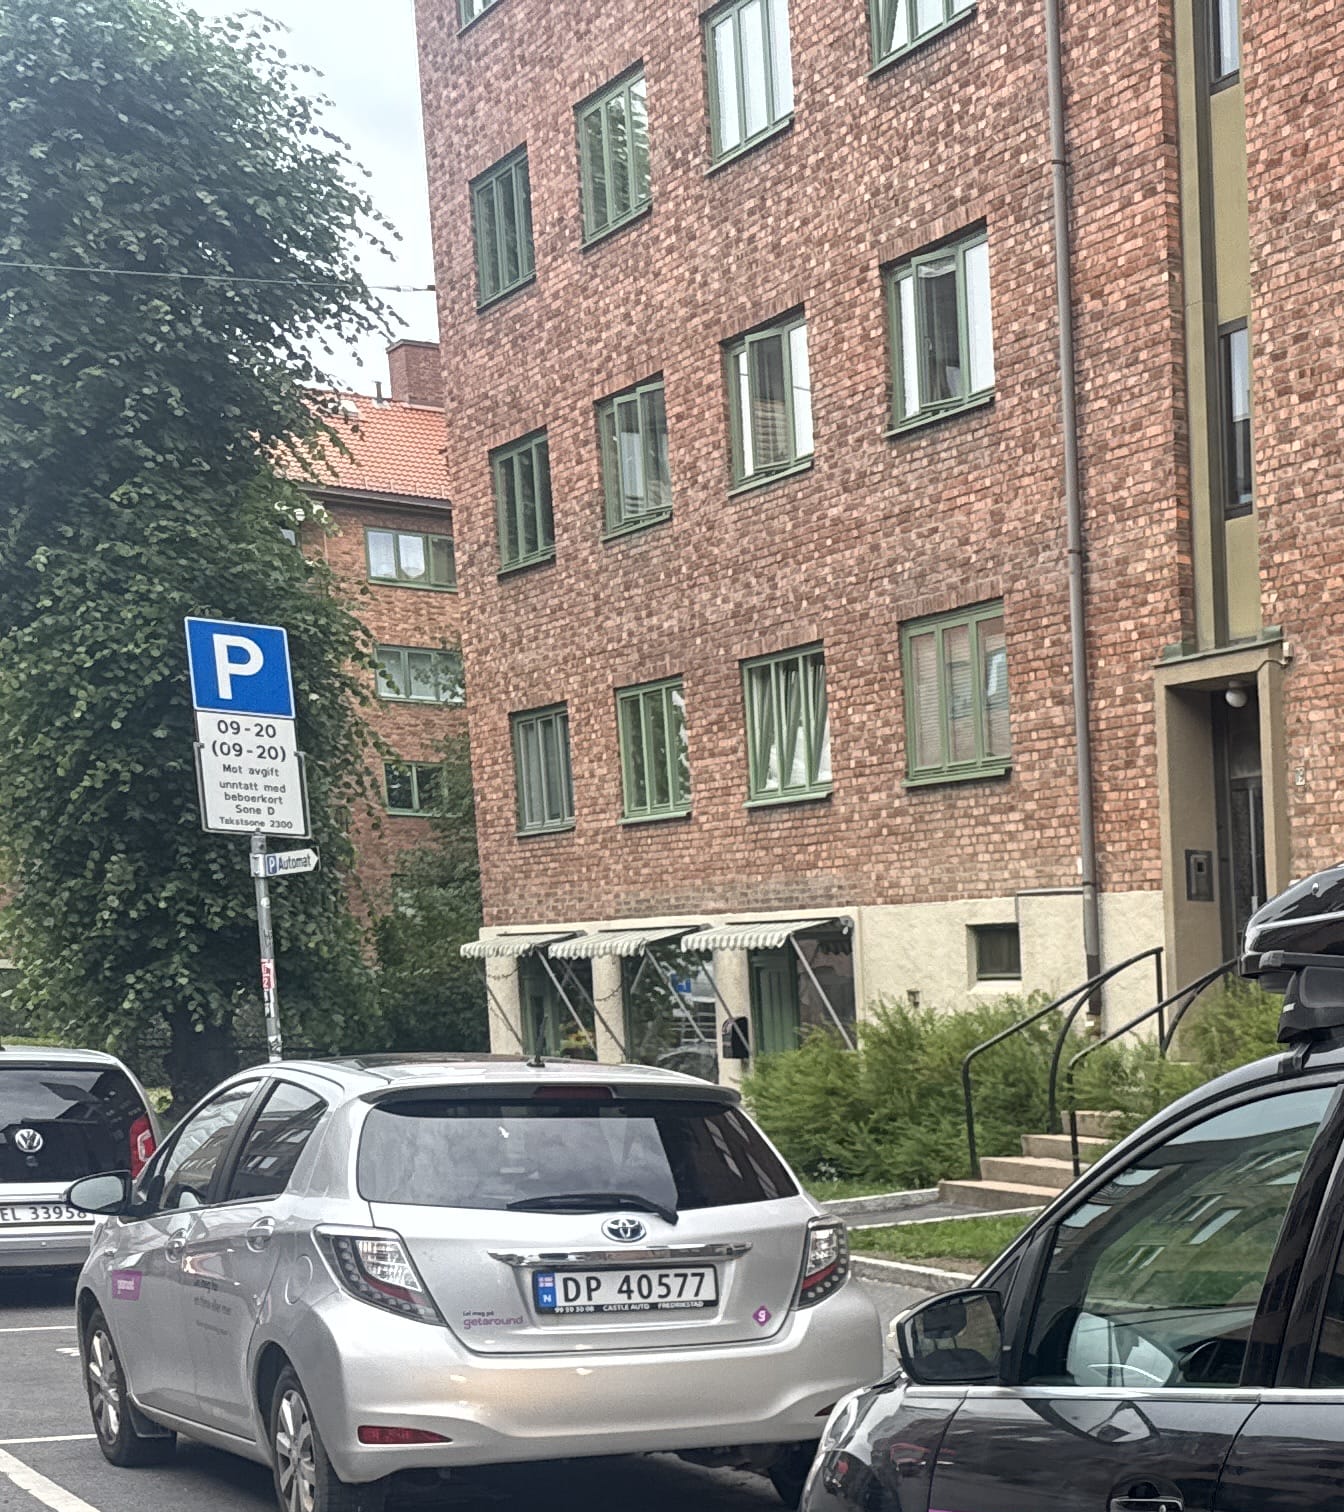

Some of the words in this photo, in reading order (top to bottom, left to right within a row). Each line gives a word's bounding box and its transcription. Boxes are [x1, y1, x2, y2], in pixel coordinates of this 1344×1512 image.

[212, 633, 264, 700] P
[223, 763, 243, 775] Mot
[248, 767, 280, 778] avgift
[219, 780, 259, 791] unntatt
[264, 784, 286, 793] med
[224, 791, 283, 805] beboerkort
[235, 804, 262, 815] Sone
[267, 806, 276, 816] D
[279, 854, 312, 871] Automat
[0, 1207, 21, 1221] EL
[563, 1275, 601, 1303] DP
[617, 1272, 706, 1301] 40577
[602, 1304, 630, 1312] CASTLE
[463, 1315, 524, 1330] getaround
